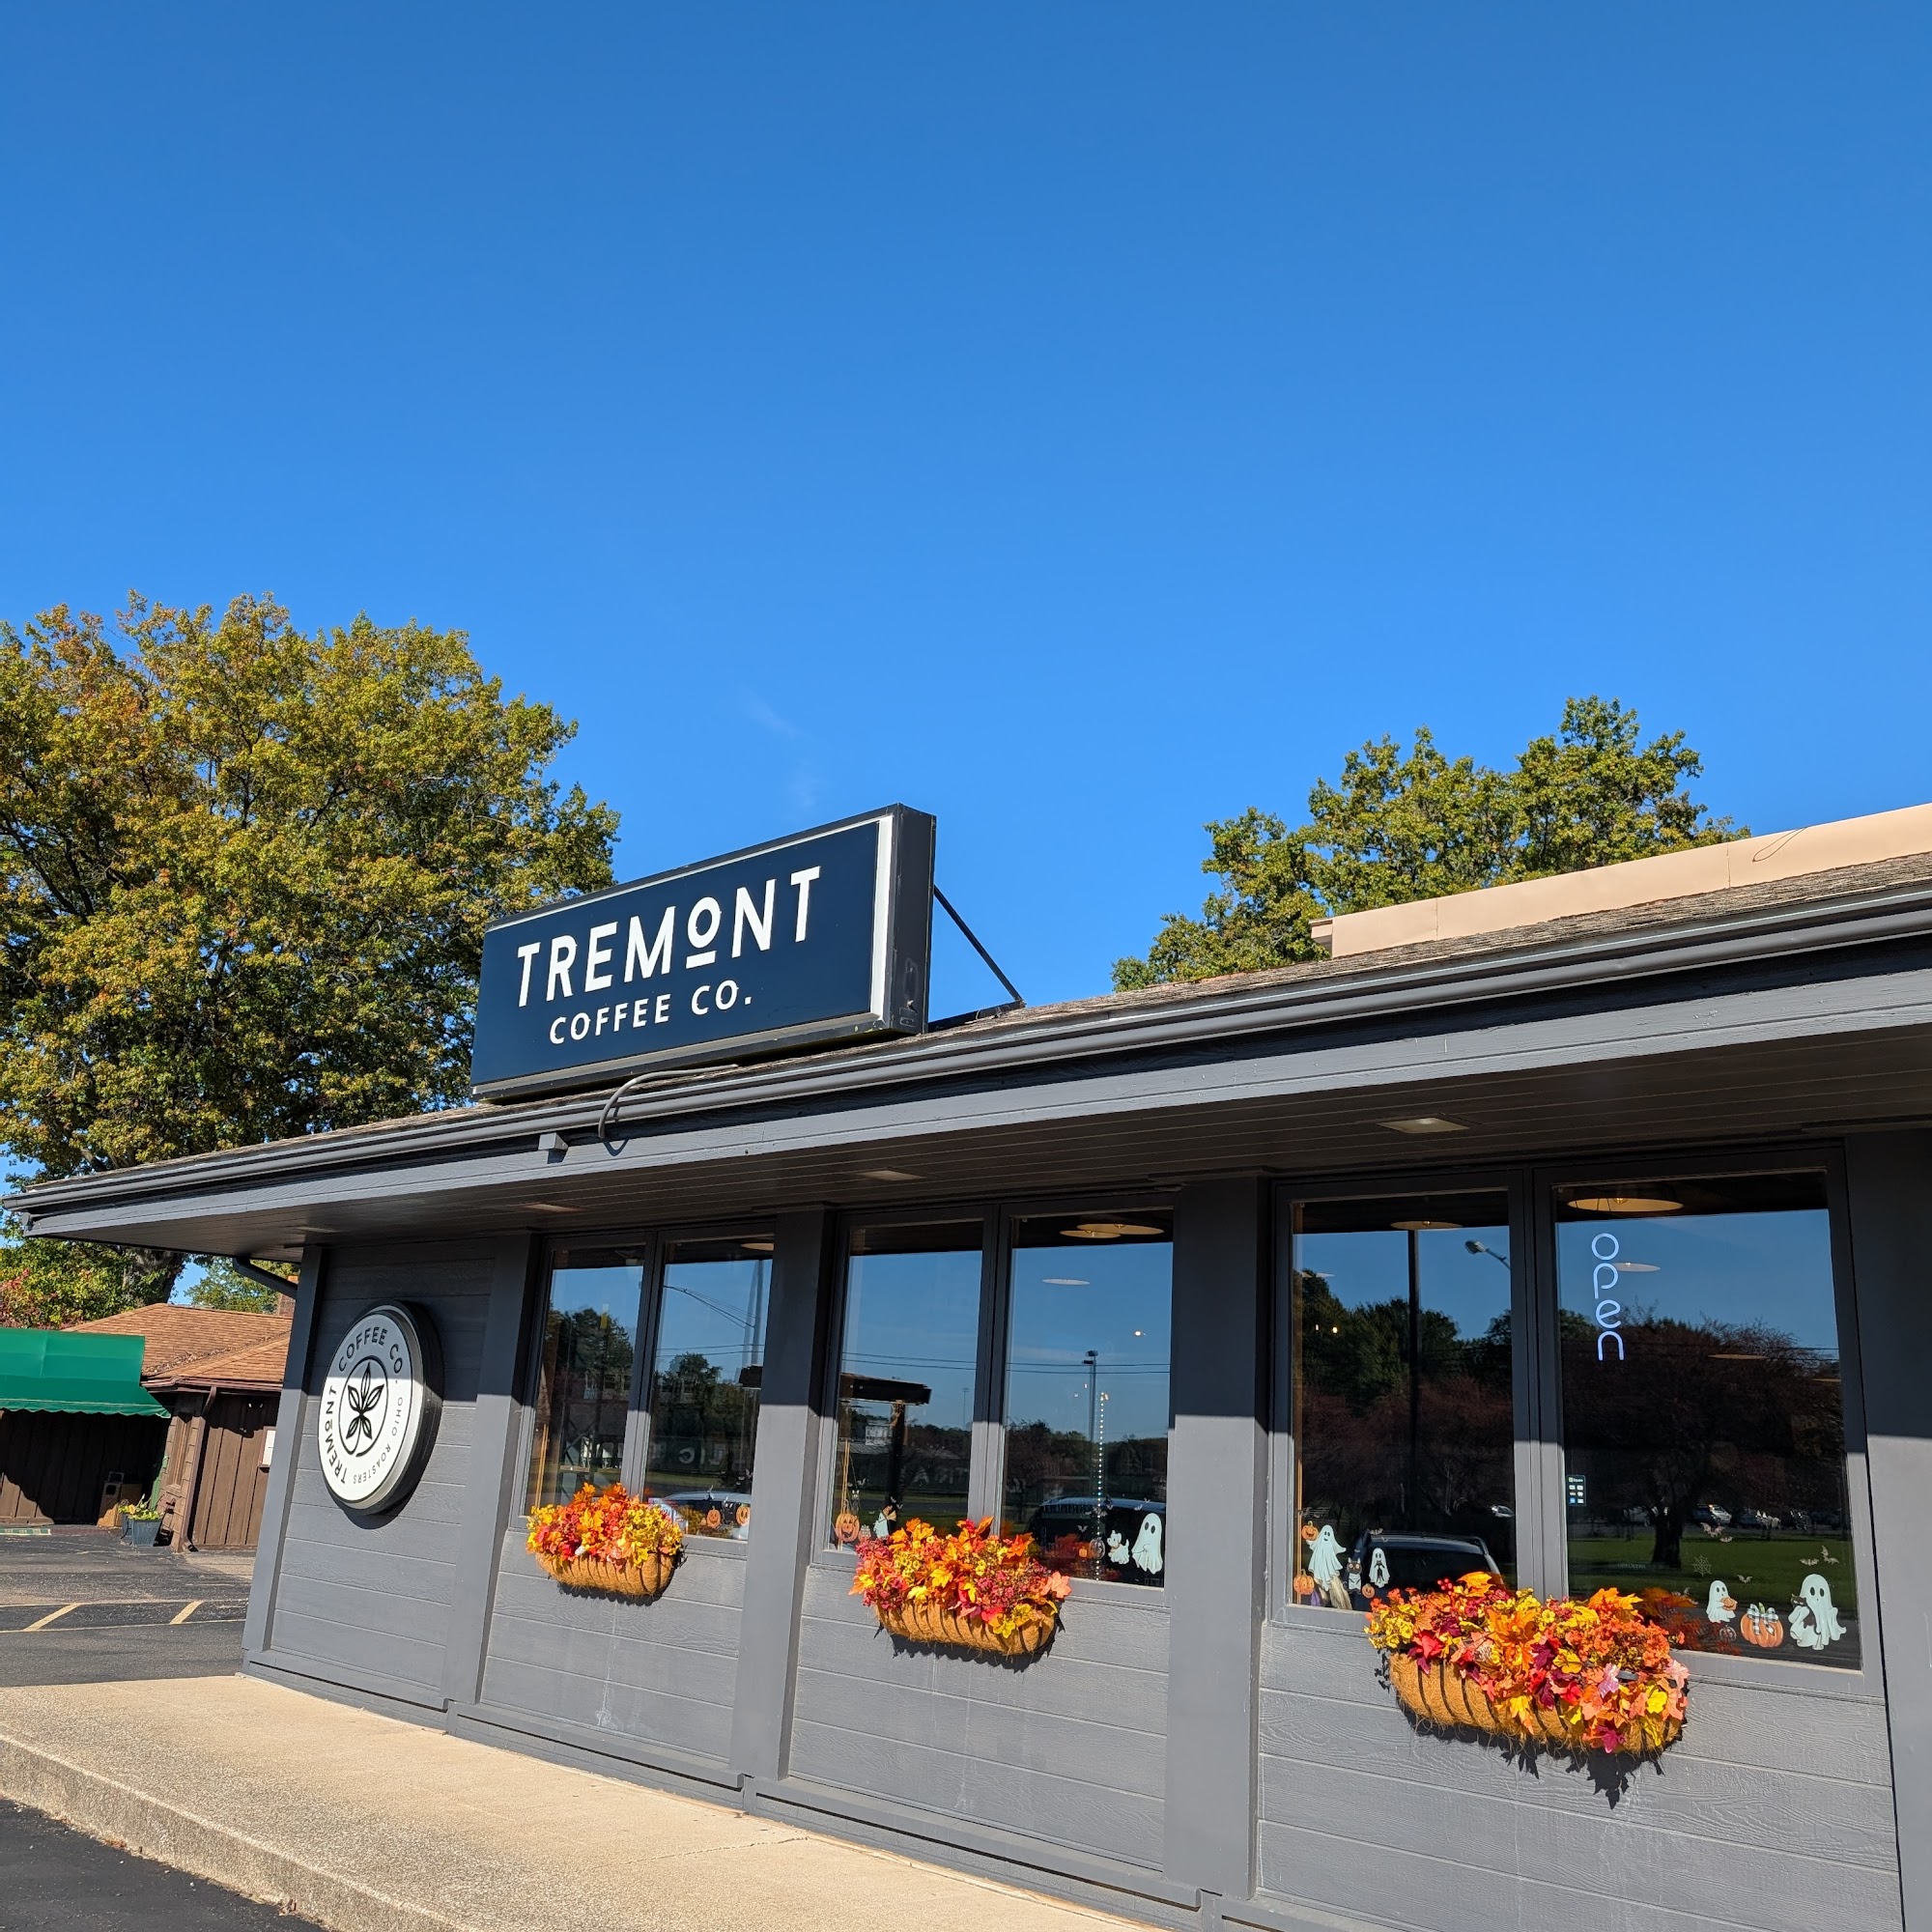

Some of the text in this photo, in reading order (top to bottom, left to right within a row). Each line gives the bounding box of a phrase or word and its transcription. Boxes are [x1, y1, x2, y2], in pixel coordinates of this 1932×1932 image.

[517, 866, 821, 1009] TREMONT
[549, 980, 753, 1045] COFFEE CO.
[1591, 1233, 1624, 1361] open
[325, 1385, 348, 1485] TREMONT
[338, 1326, 388, 1372] COFFEE
[353, 1397, 404, 1485] OHIO ROASTERS
